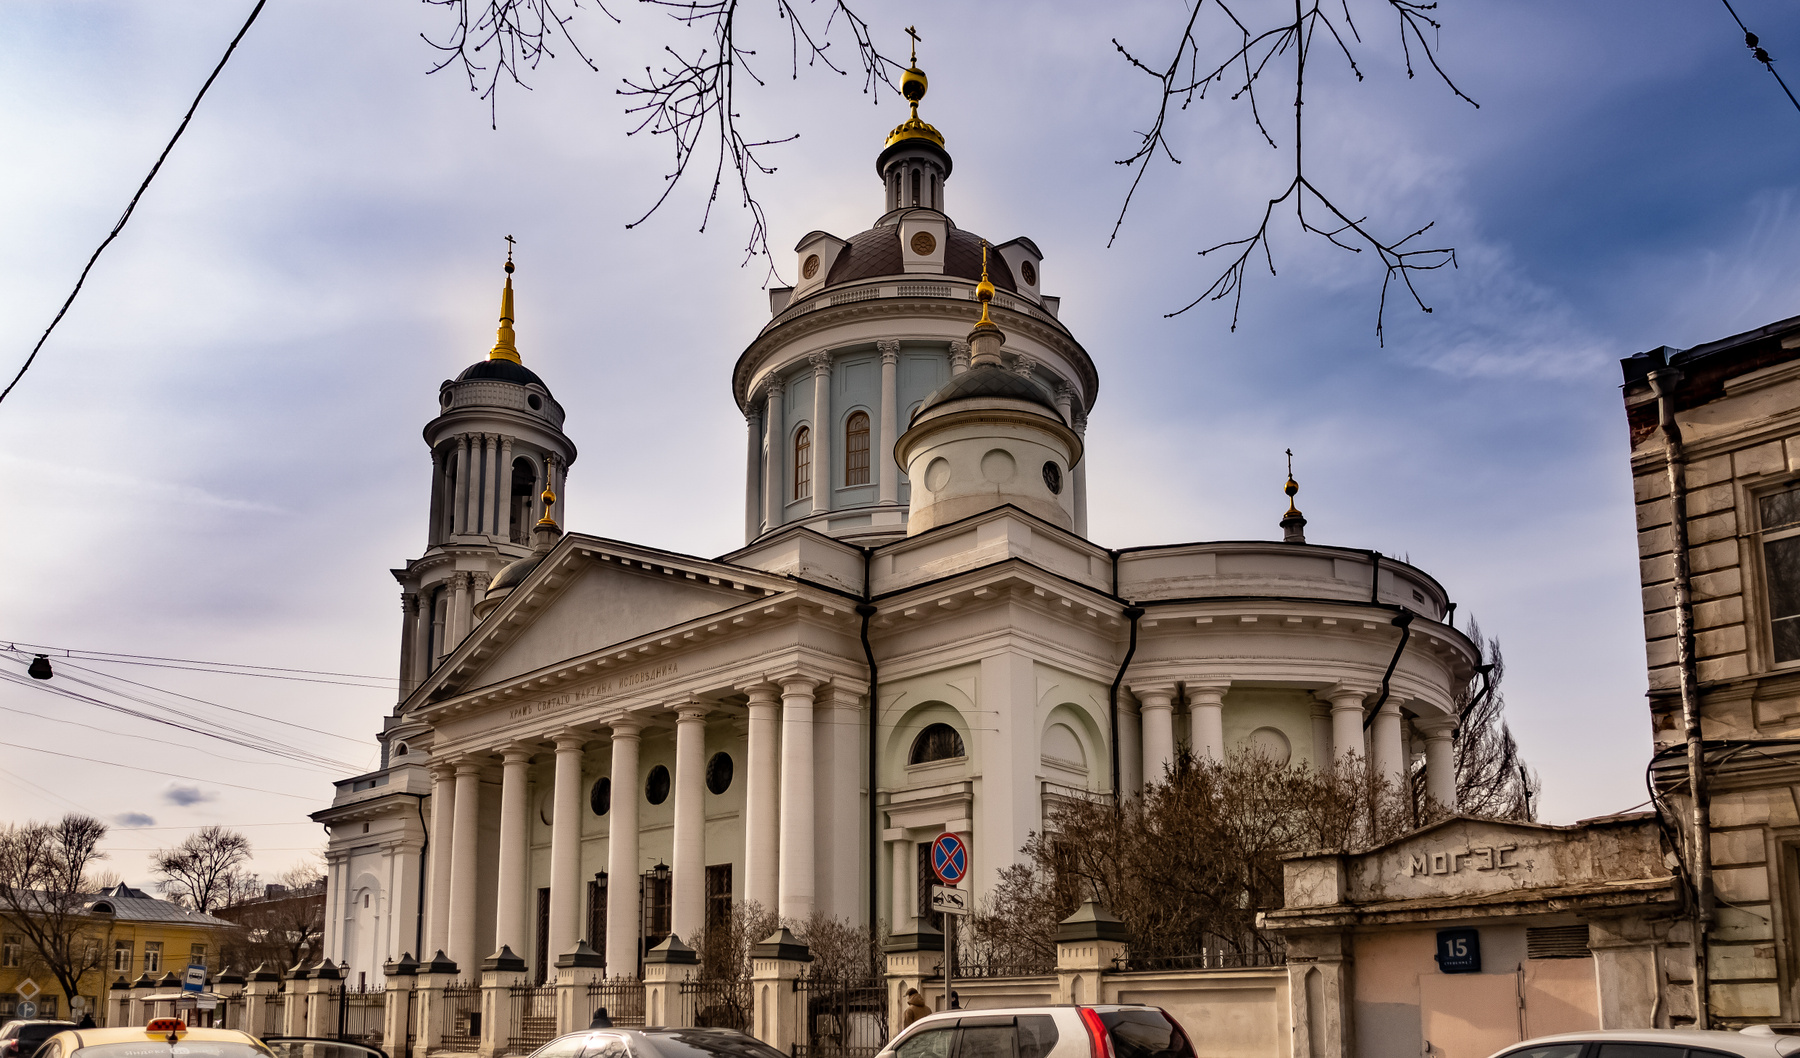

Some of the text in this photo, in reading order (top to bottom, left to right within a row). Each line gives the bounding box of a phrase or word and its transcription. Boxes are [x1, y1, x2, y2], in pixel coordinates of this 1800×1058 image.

[509, 704, 533, 720] ХРАМЪ
[537, 694, 570, 712] СВЯТАГО
[575, 682, 613, 702] МАРТИНА
[1408, 844, 1519, 878] МОГЭС
[1445, 938, 1468, 957] 15
